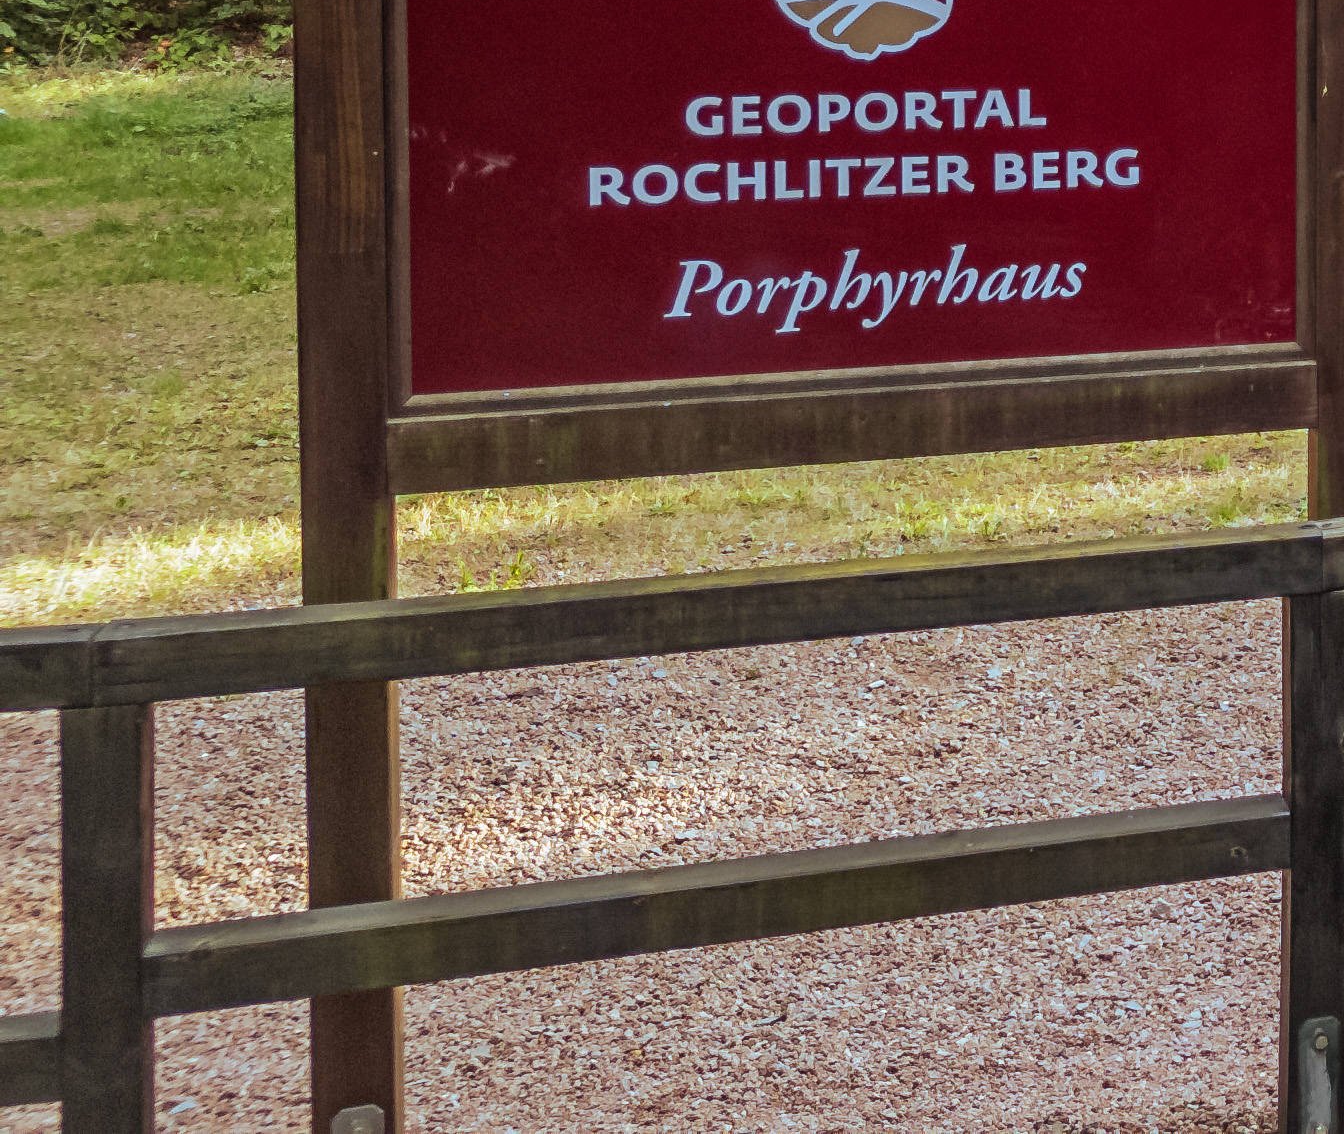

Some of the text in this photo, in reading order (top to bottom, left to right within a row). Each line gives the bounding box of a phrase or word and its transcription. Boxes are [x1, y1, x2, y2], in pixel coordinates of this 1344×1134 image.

[685, 88, 1047, 136] GEOPORTAL
[588, 148, 1140, 207] ROCHLITZER BERG
[662, 243, 1087, 335] Porphyrhaus
